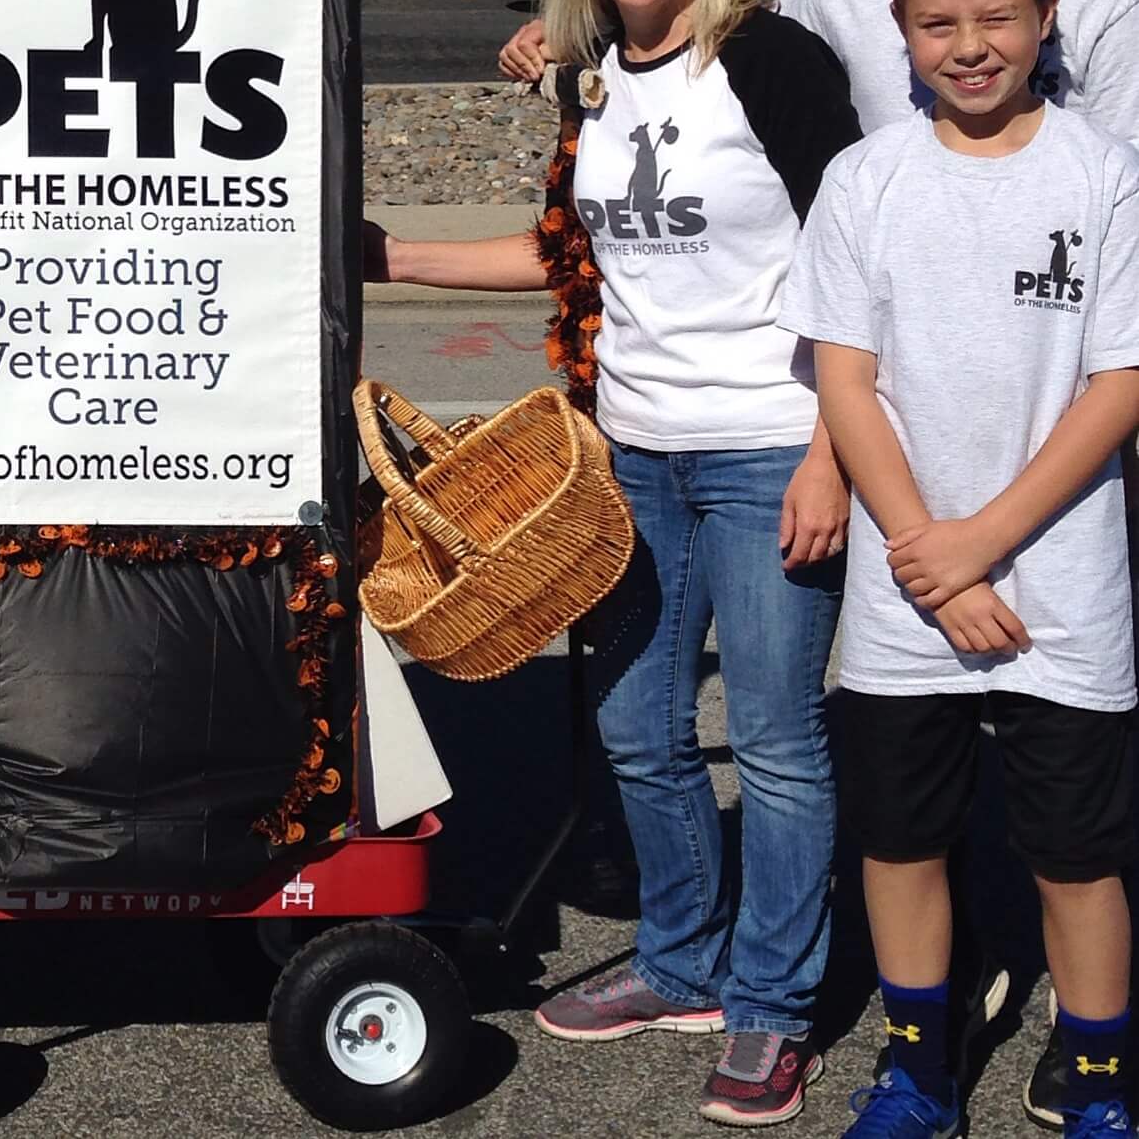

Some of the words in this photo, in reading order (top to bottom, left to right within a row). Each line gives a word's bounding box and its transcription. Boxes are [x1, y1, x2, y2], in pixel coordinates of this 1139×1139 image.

[78, 174, 289, 208] HOMELESS
[32, 211, 134, 231] National
[141, 211, 296, 236] Organization
[577, 196, 708, 239] PETS
[606, 243, 629, 256] THE
[632, 240, 710, 256] HOMELESS
[1014, 270, 1086, 303] PETS
[67, 298, 185, 336] Food
[198, 298, 229, 337] &
[1014, 298, 1026, 306] OF
[1028, 299, 1042, 309] THE
[1044, 301, 1081, 314] HOMELESS
[48, 388, 159, 425] Care
